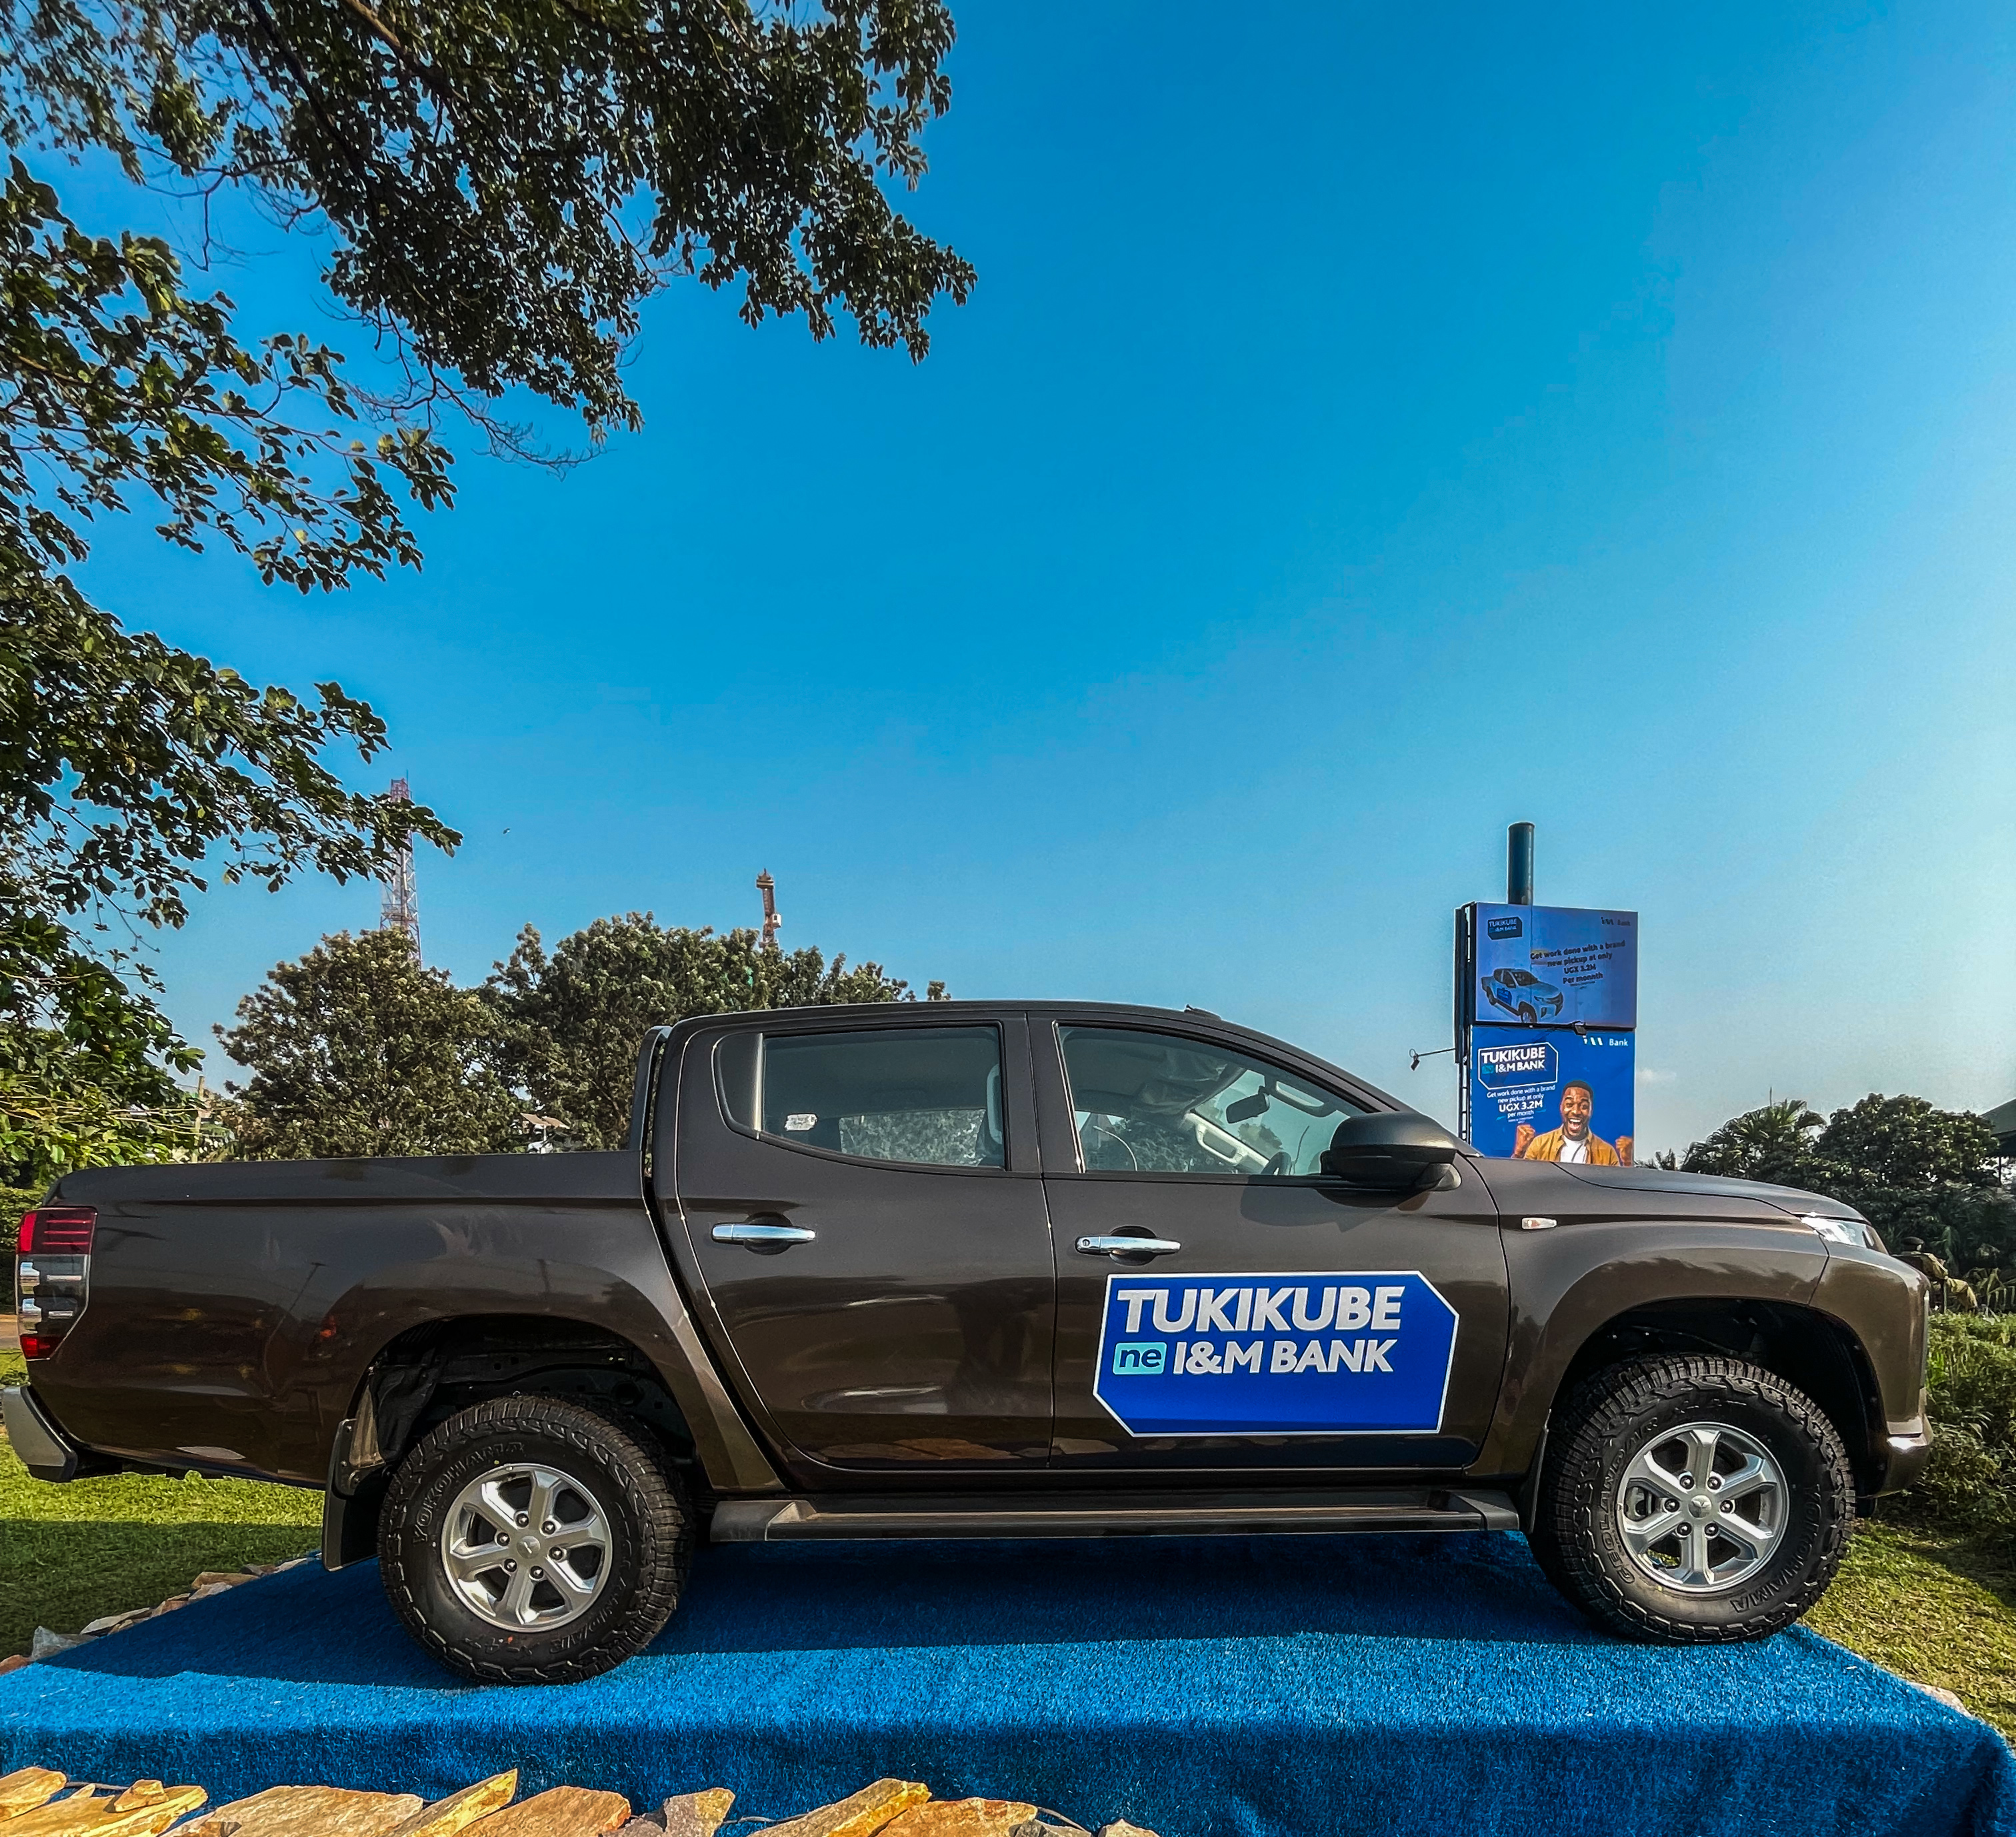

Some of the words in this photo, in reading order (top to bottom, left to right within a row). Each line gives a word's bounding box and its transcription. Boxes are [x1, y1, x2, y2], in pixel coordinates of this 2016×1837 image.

[1544, 950, 1562, 958] work
[1563, 948, 1581, 956] done
[1582, 944, 1598, 952] with
[1605, 940, 1626, 949] brand
[1564, 955, 1588, 966] pickup
[1597, 952, 1613, 960] only
[1609, 1038, 1629, 1046] Bank
[1481, 1046, 1545, 1064] TUKIKUBE
[1495, 1063, 1515, 1073] I&M
[1517, 1059, 1545, 1071] BANK
[1499, 1102, 1519, 1112] UGX
[1521, 1100, 1543, 1110] 3.2M
[1117, 1285, 1405, 1334] TUKIKUBE
[1119, 1347, 1162, 1369] ne
[1172, 1340, 1264, 1375] I&M
[1269, 1339, 1399, 1374] BANK
